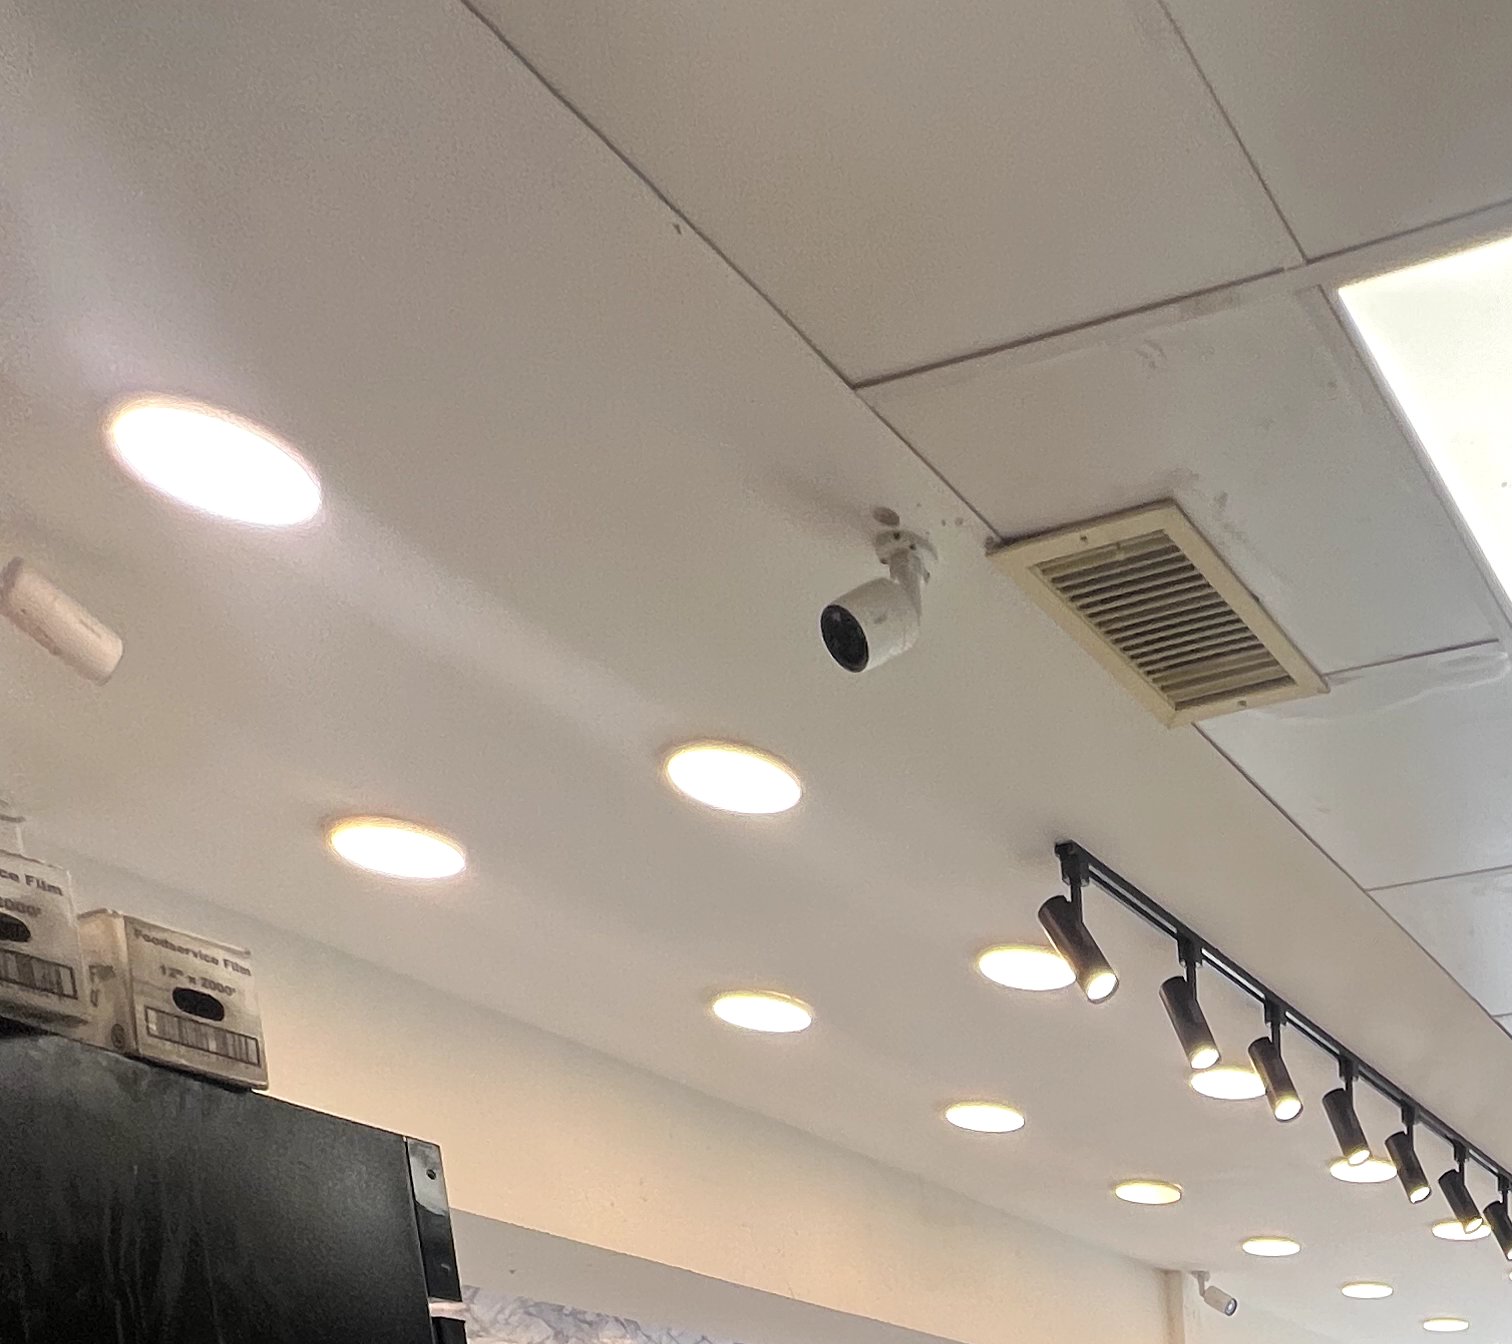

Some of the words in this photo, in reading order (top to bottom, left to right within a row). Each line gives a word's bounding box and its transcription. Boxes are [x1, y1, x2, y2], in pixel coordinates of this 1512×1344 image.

[25, 874, 63, 896] Film
[134, 928, 219, 966] Foodservice
[223, 957, 251, 977] Film
